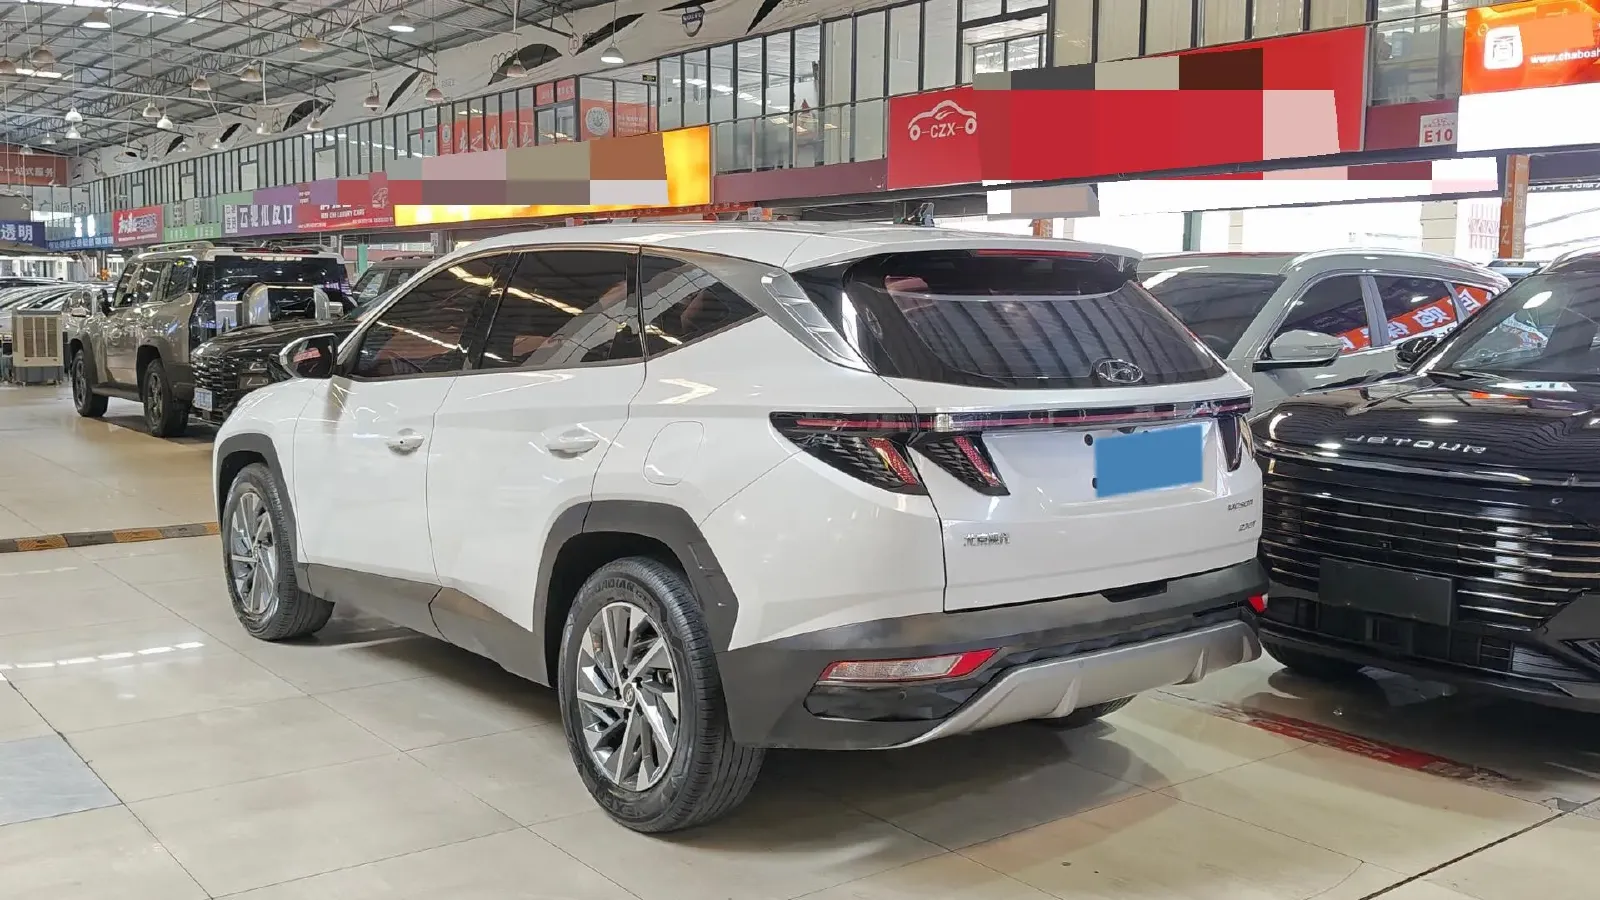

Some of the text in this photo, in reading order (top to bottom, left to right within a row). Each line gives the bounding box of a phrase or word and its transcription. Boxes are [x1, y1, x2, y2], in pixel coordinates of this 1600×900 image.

[930, 121, 956, 138] CZX
[1424, 127, 1453, 143] E10
[0, 223, 33, 242] 透明
